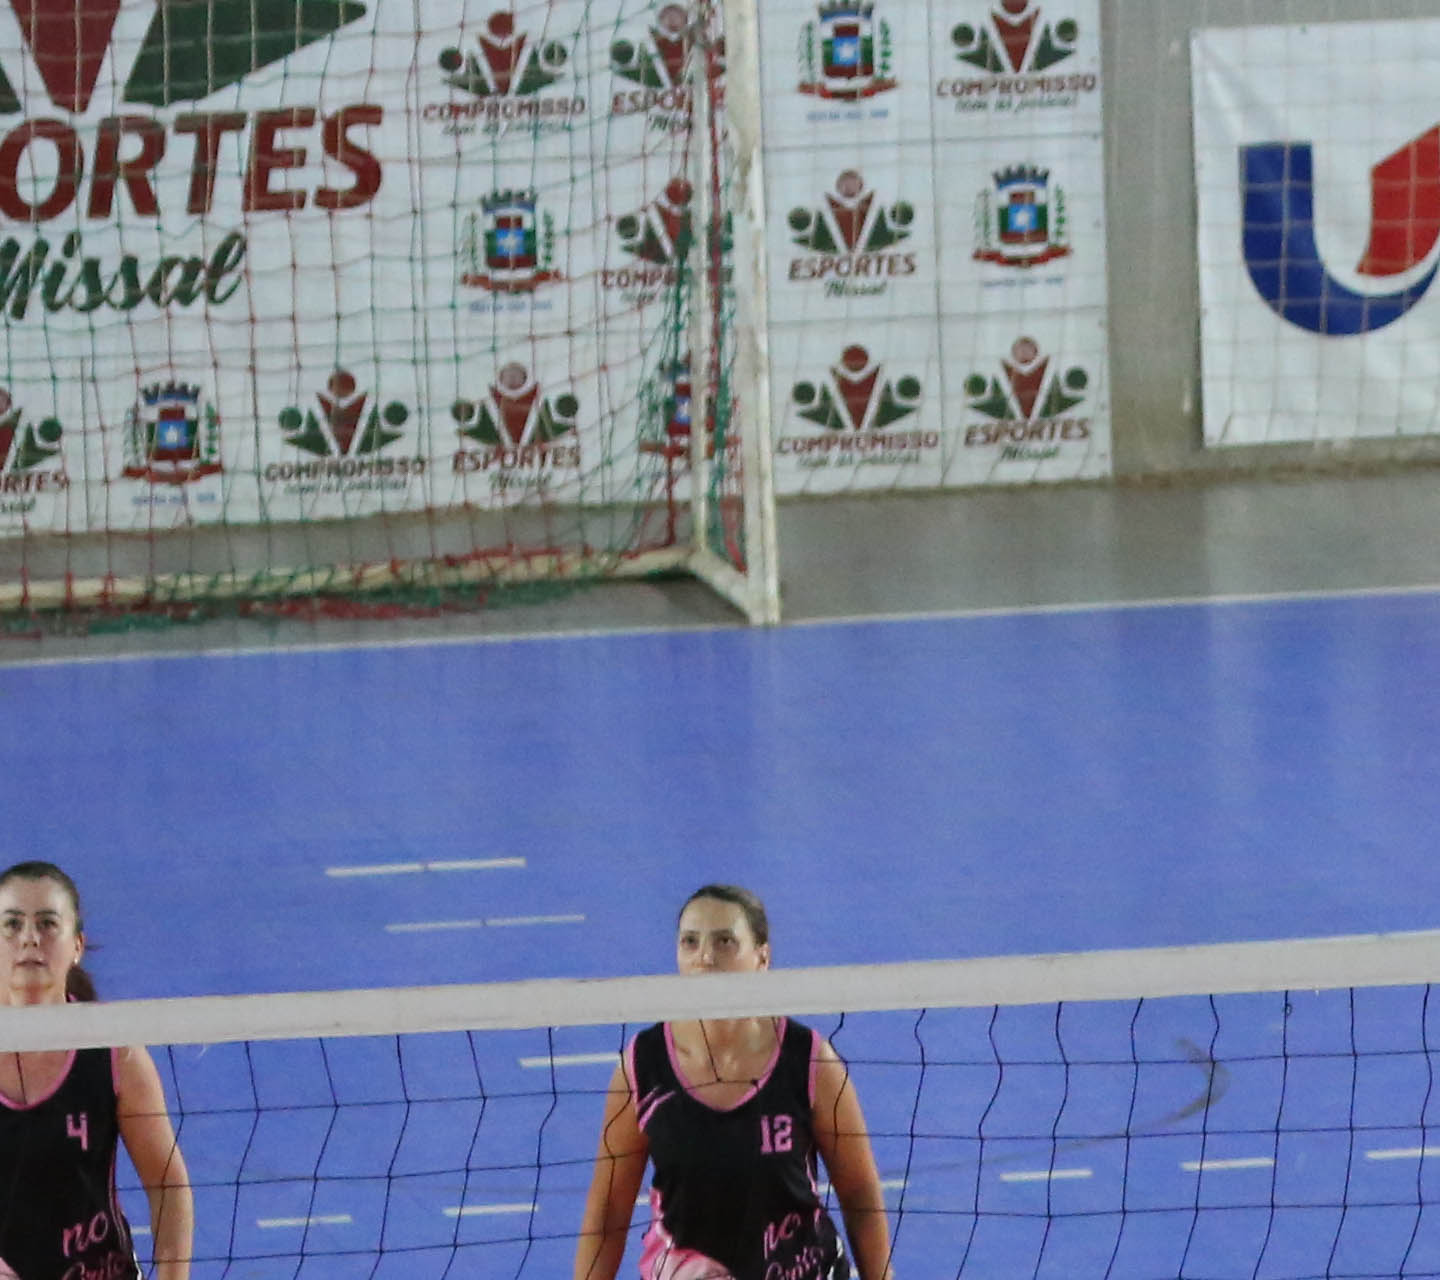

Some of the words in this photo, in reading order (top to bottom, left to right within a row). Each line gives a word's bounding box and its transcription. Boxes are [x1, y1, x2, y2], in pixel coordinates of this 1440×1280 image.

[936, 74, 1097, 97] COMPROMISSO
[423, 96, 586, 121] COMPROMISSO
[788, 253, 917, 282] ESPORTES
[777, 431, 940, 455] COMPROMISSO
[964, 419, 1090, 447] ESPORTES
[66, 1112, 88, 1151] 4
[760, 1115, 792, 1155] 12
